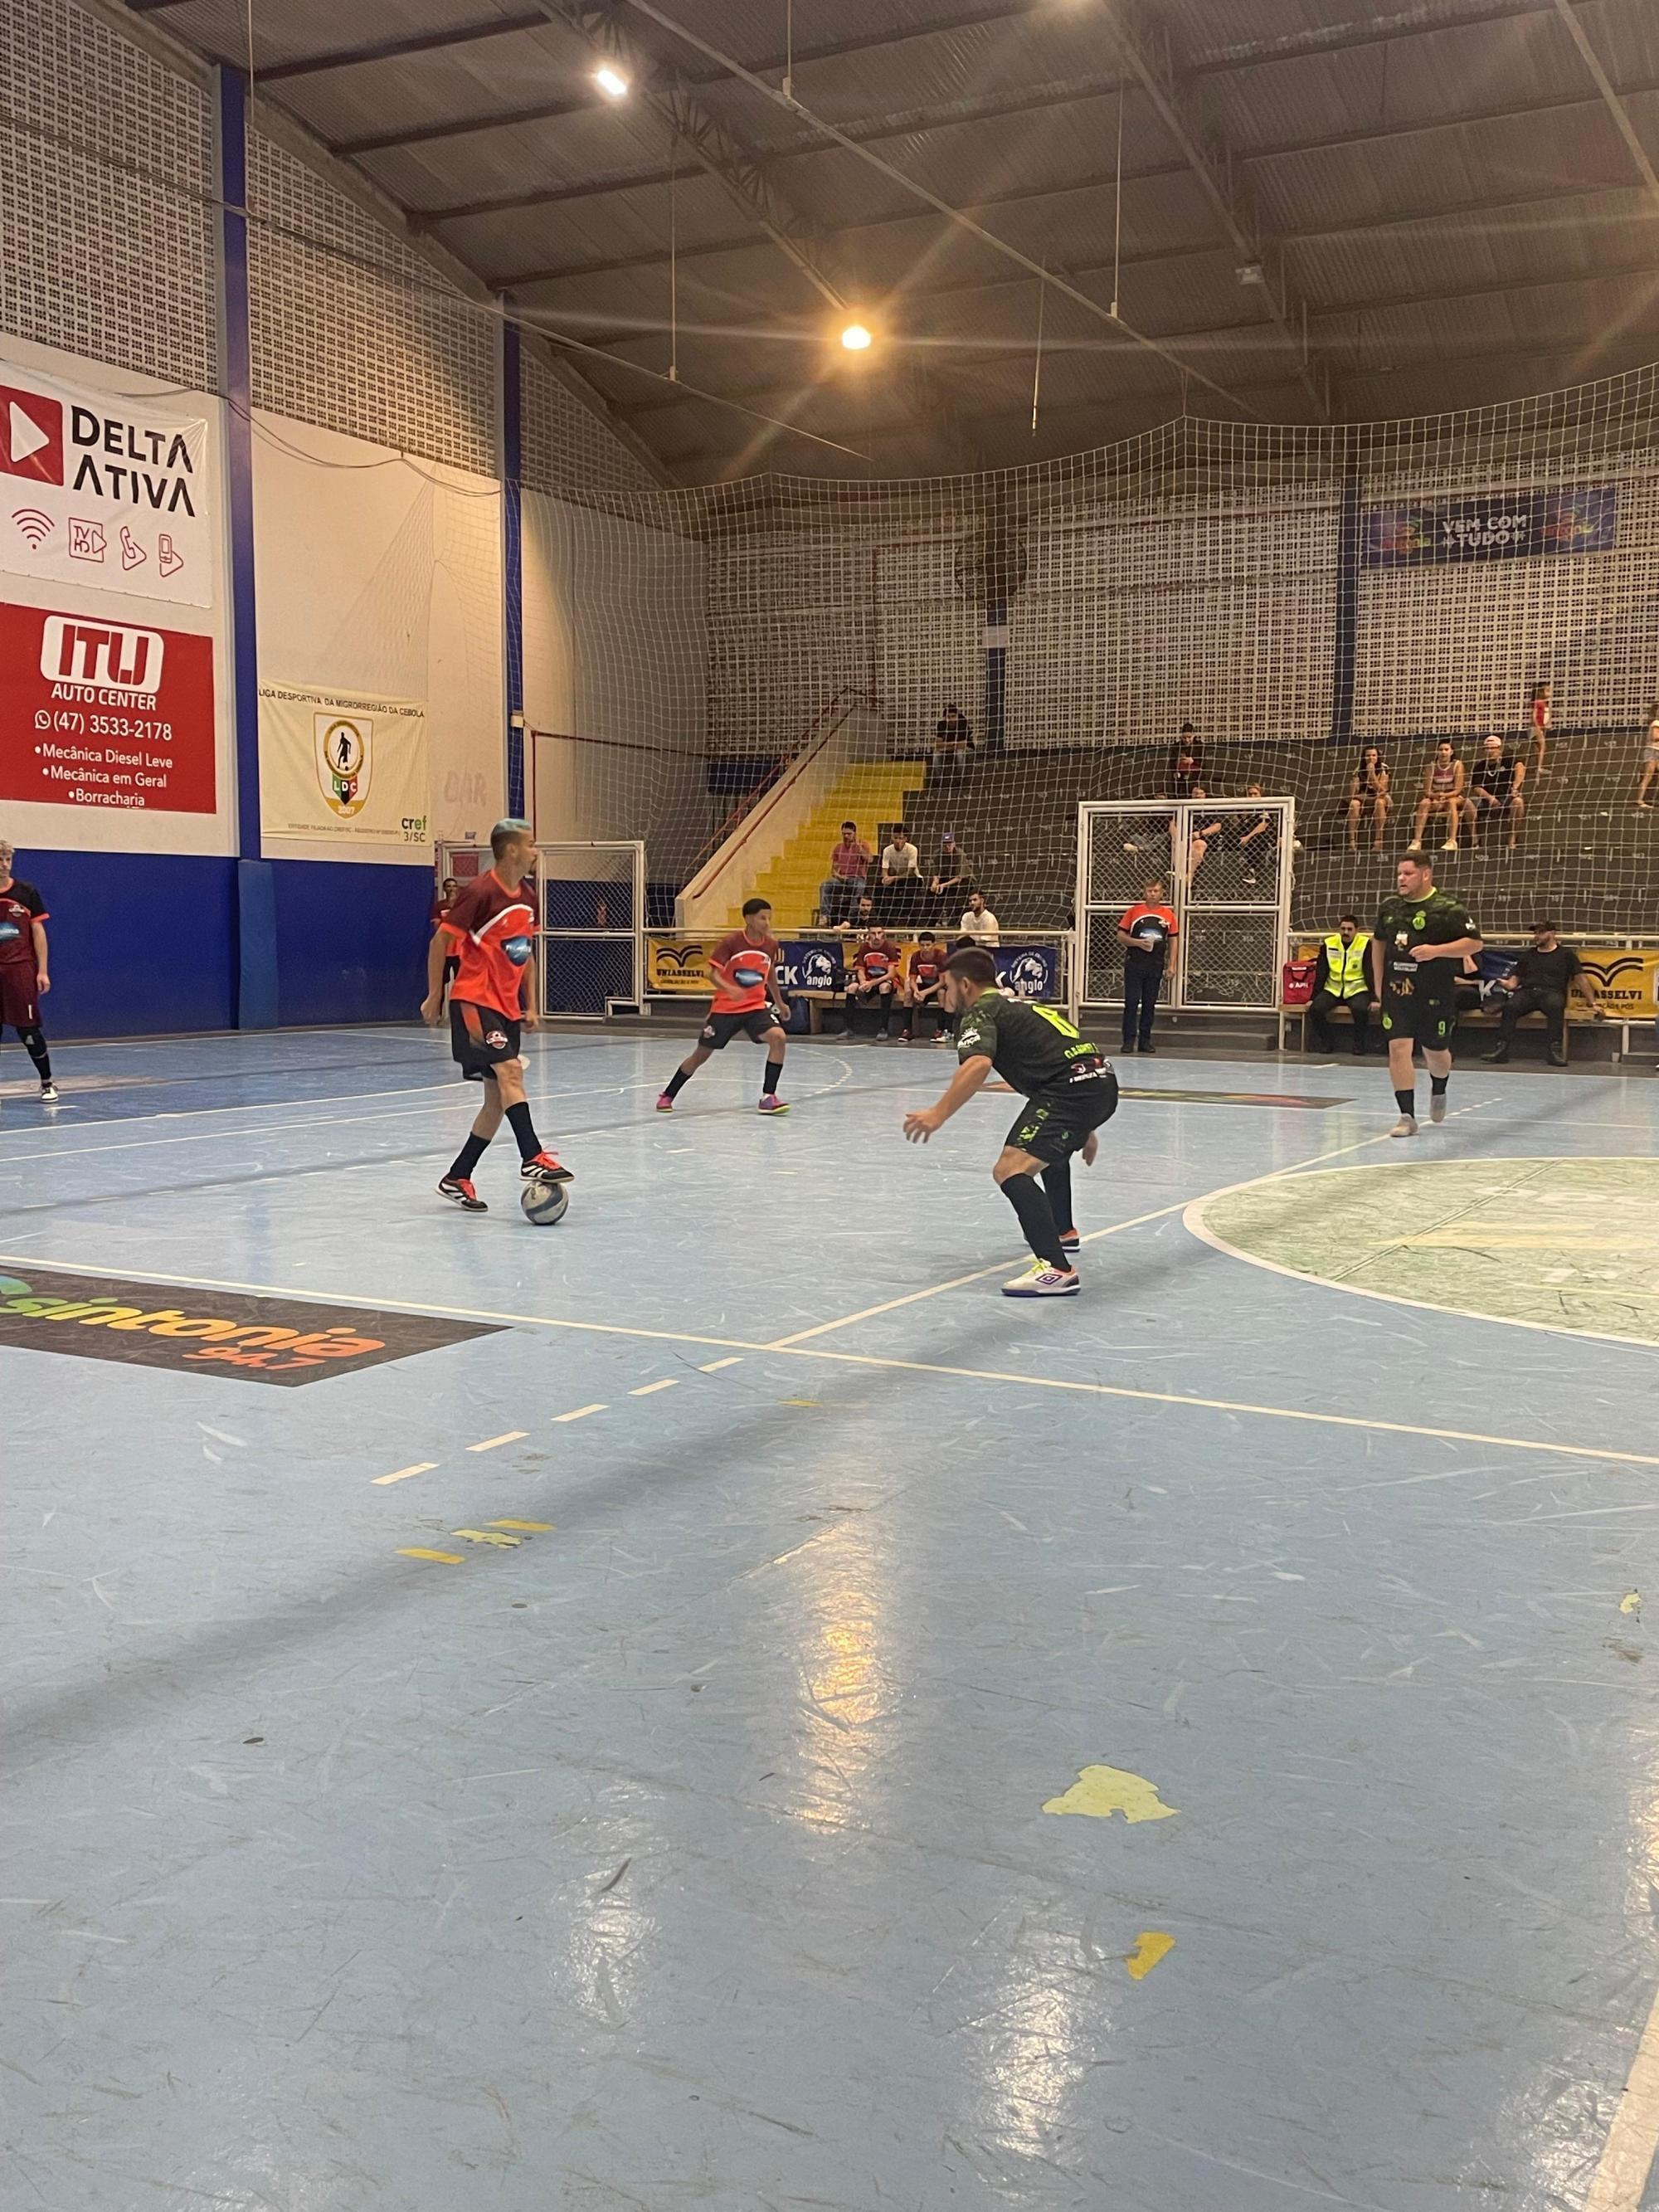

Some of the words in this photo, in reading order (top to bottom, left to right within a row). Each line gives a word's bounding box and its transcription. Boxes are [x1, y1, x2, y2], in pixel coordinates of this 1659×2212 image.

[71, 405, 193, 474] DELTA
[73, 454, 196, 518] ATIVA
[74, 525, 90, 539] TV
[1442, 518, 1481, 534] VEM
[1486, 514, 1527, 531] COM
[75, 539, 90, 553] HD
[1457, 530, 1510, 548] TUDO
[51, 683, 95, 704] AUTO
[98, 689, 157, 711] CENTER
[259, 689, 276, 699] LIGA
[277, 690, 322, 704] DESPORTIVA
[324, 698, 335, 707] DA
[389, 706, 398, 715] DA
[399, 707, 425, 719] CEBOLA
[53, 710, 85, 735] (47)
[90, 714, 173, 741] 3533-2178
[43, 743, 102, 763] Mecânica
[105, 748, 143, 767] Diesel
[145, 753, 173, 769] Leve
[51, 766, 109, 783] Mecânica
[113, 772, 132, 785] em
[134, 772, 168, 788] Geral
[75, 788, 145, 806] Borracharia
[401, 815, 427, 831] cref
[403, 831, 426, 843] 3/SC
[806, 974, 832, 988] anglo
[1014, 978, 1044, 994] anglo
[1571, 988, 1642, 1000] UNASSELVI
[1438, 1021, 1446, 1035] 9
[0, 1298, 386, 1357] sintonia
